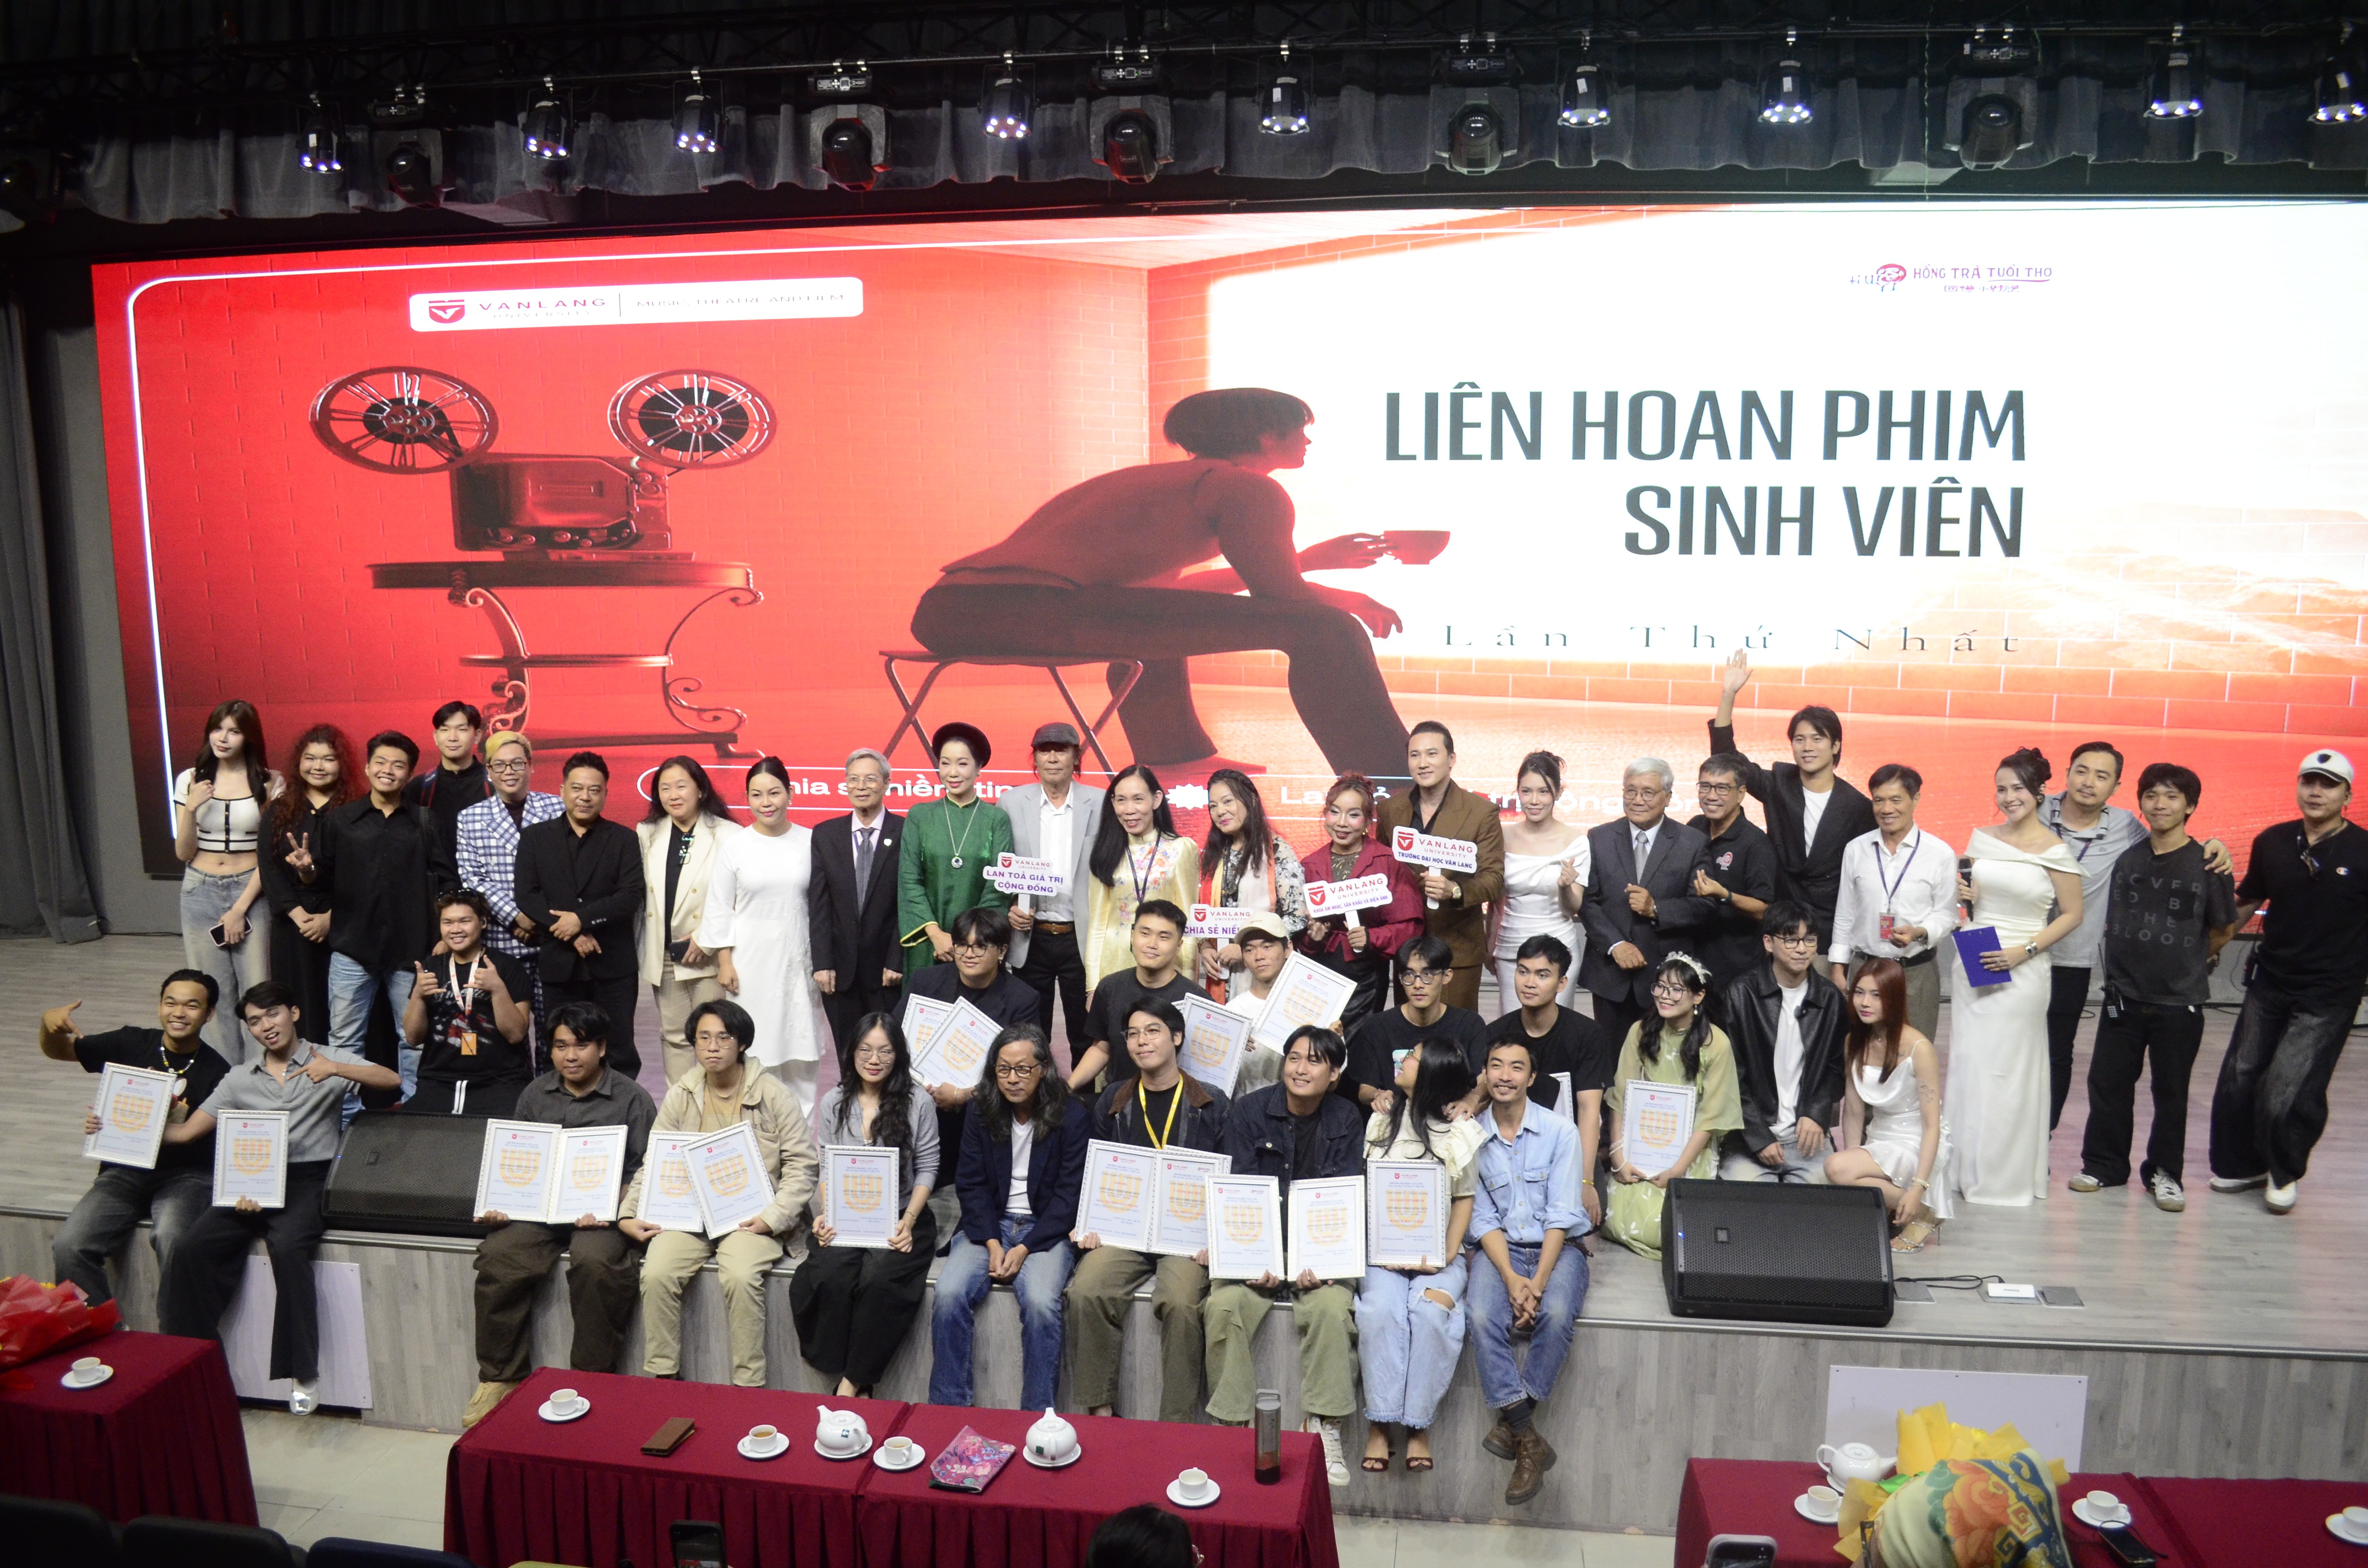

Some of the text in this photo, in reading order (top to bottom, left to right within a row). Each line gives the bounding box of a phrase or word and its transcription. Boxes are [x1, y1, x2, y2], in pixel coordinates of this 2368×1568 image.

[479, 298, 605, 310] VANLANG
[1386, 381, 2024, 460] LIÊN HOAN PHIM
[1626, 477, 2023, 557] SINH VIÊN
[1445, 625, 2019, 651] Lần Thứ Nhất
[1419, 838, 1473, 853] VANLANG
[1424, 848, 1466, 858] UNIVERSITY
[1029, 873, 1046, 882] GIÁ
[1048, 876, 1063, 885] TRỊ
[998, 881, 1024, 890] CỘNG
[1330, 878, 1384, 894] VANLANG
[1337, 888, 1379, 899] UNIVERSITY
[1208, 924, 1219, 934] SẺ
[1222, 924, 1239, 934] NIỀ
